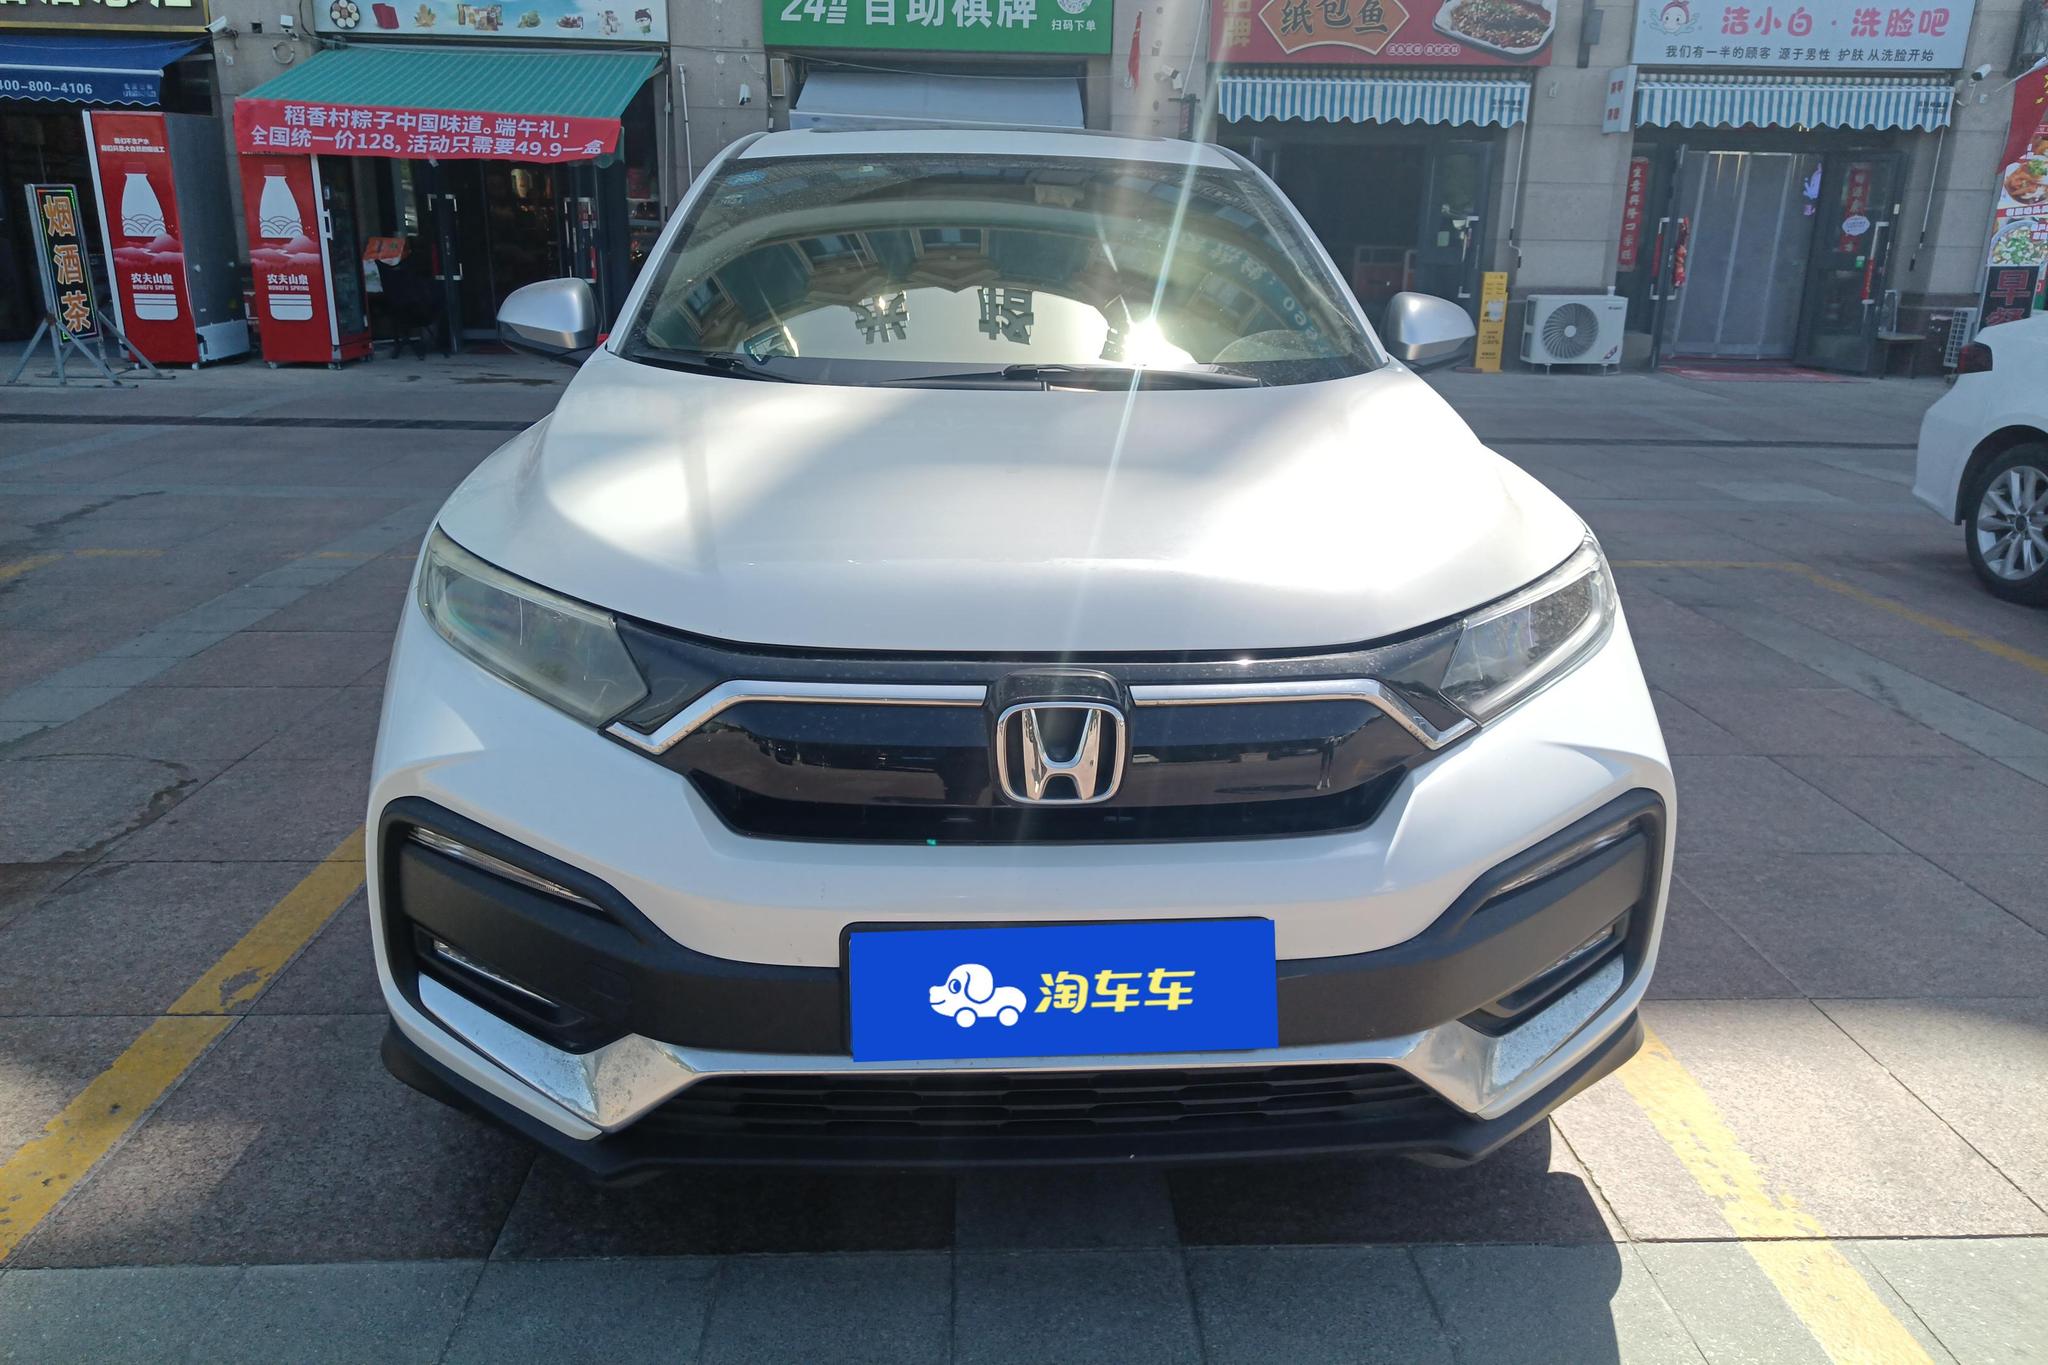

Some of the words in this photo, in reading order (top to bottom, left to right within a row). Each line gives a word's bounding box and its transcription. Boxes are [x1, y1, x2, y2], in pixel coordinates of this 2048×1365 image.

[1280, 0, 1388, 35] 纸包鱼
[1051, 19, 1096, 31] 扫码下单
[44, 195, 91, 332] 烟酒茶
[131, 273, 174, 284] 农夫山泉
[267, 274, 309, 285] 农夫山泉
